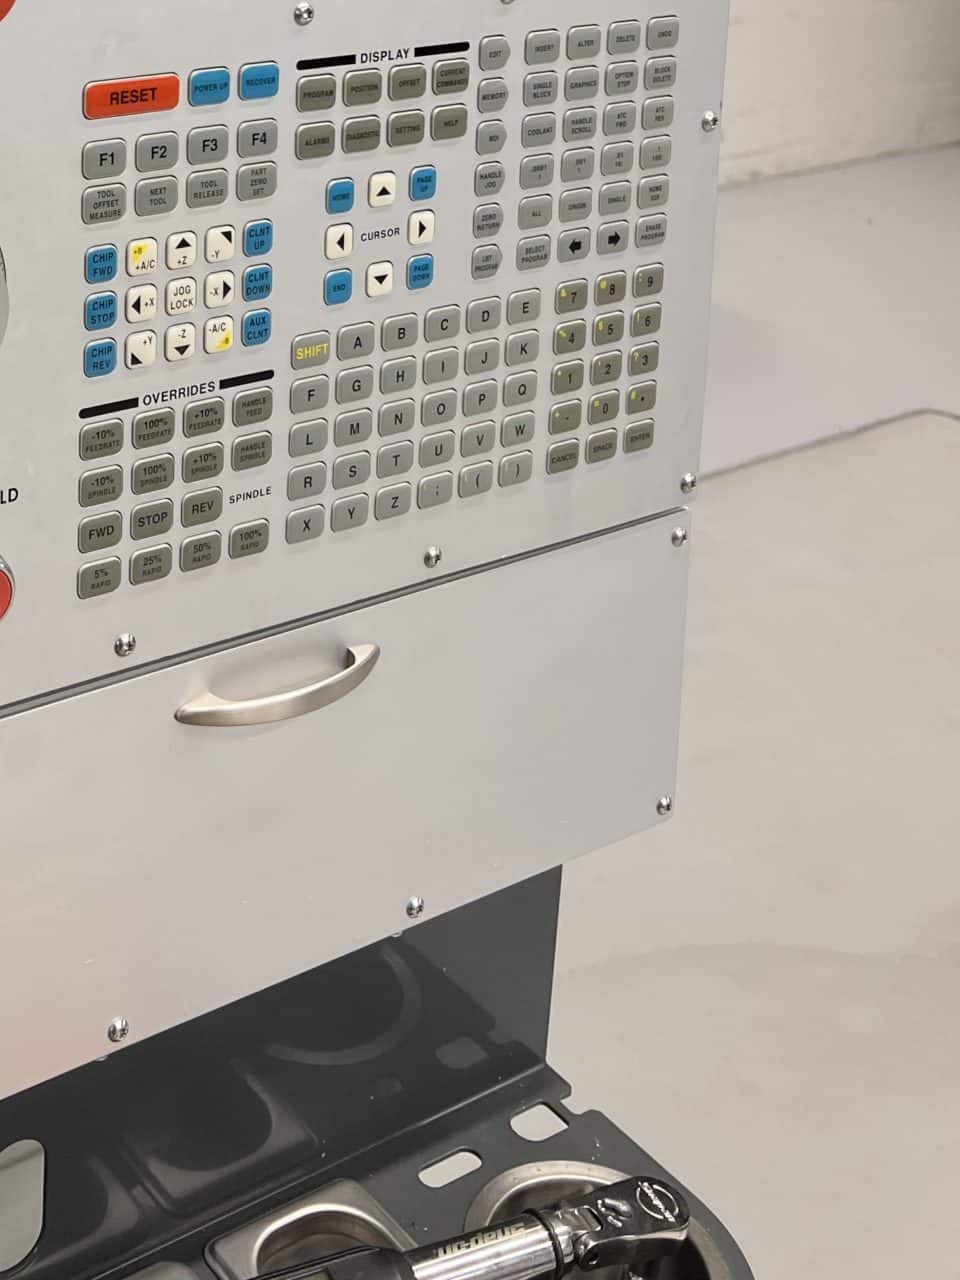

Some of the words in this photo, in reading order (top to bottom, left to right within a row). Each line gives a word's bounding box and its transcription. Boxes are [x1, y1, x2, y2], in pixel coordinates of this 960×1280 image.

[360, 48, 410, 65] DISPLAY
[110, 88, 157, 105] RESET
[252, 132, 267, 146] F4
[202, 139, 218, 152] F3
[151, 146, 167, 159] F2
[100, 152, 114, 166] F1
[201, 180, 218, 188] TOOL
[97, 190, 116, 199] TOOL
[150, 187, 166, 196] NEXT
[93, 199, 118, 209] OFFSET
[150, 197, 166, 206] TOOL
[249, 227, 270, 238] CLNT
[360, 227, 401, 243] CURSOR
[254, 241, 265, 251] UP
[93, 253, 113, 264] CHIP
[177, 256, 188, 265] +Z
[136, 260, 156, 271] +A/C
[93, 267, 113, 277] FWD
[248, 272, 269, 283] CLNT
[648, 276, 653, 287] 9
[173, 285, 191, 297] JOG
[247, 284, 270, 296] DOWN
[610, 284, 615, 295] 8
[144, 297, 154, 307] +X
[571, 292, 577, 303] 7
[92, 300, 113, 311] CHIP
[171, 299, 193, 310] LOCK
[522, 302, 529, 314] E
[91, 313, 114, 325] STOP
[250, 315, 266, 326] AUX
[482, 310, 490, 322] D
[645, 316, 651, 327] 6
[441, 319, 448, 330] C
[608, 324, 613, 335] 5
[248, 329, 268, 340] CLNT
[398, 328, 405, 340] B
[568, 332, 574, 344] 4
[143, 336, 153, 345] +Y
[354, 336, 362, 349] A
[92, 346, 113, 357] CHIP
[296, 343, 328, 360] SHIFT
[520, 343, 528, 355] K
[481, 352, 487, 364] J
[642, 355, 648, 366] 3
[93, 359, 111, 370] REV
[442, 361, 444, 373] I
[605, 364, 611, 375] 2
[396, 370, 404, 383] H
[568, 373, 572, 384] 1
[352, 380, 361, 392] G
[518, 384, 526, 396] Q
[143, 381, 216, 406] OVERRIDES
[308, 389, 315, 402] F
[479, 394, 486, 406] P
[194, 407, 219, 418] +10%
[437, 403, 446, 415] O
[603, 403, 608, 414] 0
[144, 418, 168, 429] 100%
[394, 413, 402, 424] N
[350, 422, 360, 435] M
[516, 424, 525, 436] W
[92, 429, 115, 441] -10%
[306, 434, 312, 445] L
[476, 434, 484, 446] V
[435, 444, 442, 456] U
[393, 454, 400, 466] T
[143, 464, 166, 475] 100%
[349, 466, 356, 478] S
[304, 476, 312, 488] R
[229, 487, 272, 504] SPINDLE
[192, 501, 214, 515] REV
[392, 496, 398, 508] Z
[348, 507, 355, 519] Y
[138, 512, 168, 528] STOP
[303, 520, 310, 532] X
[89, 525, 115, 541] FWD
[193, 542, 211, 554] 50%
